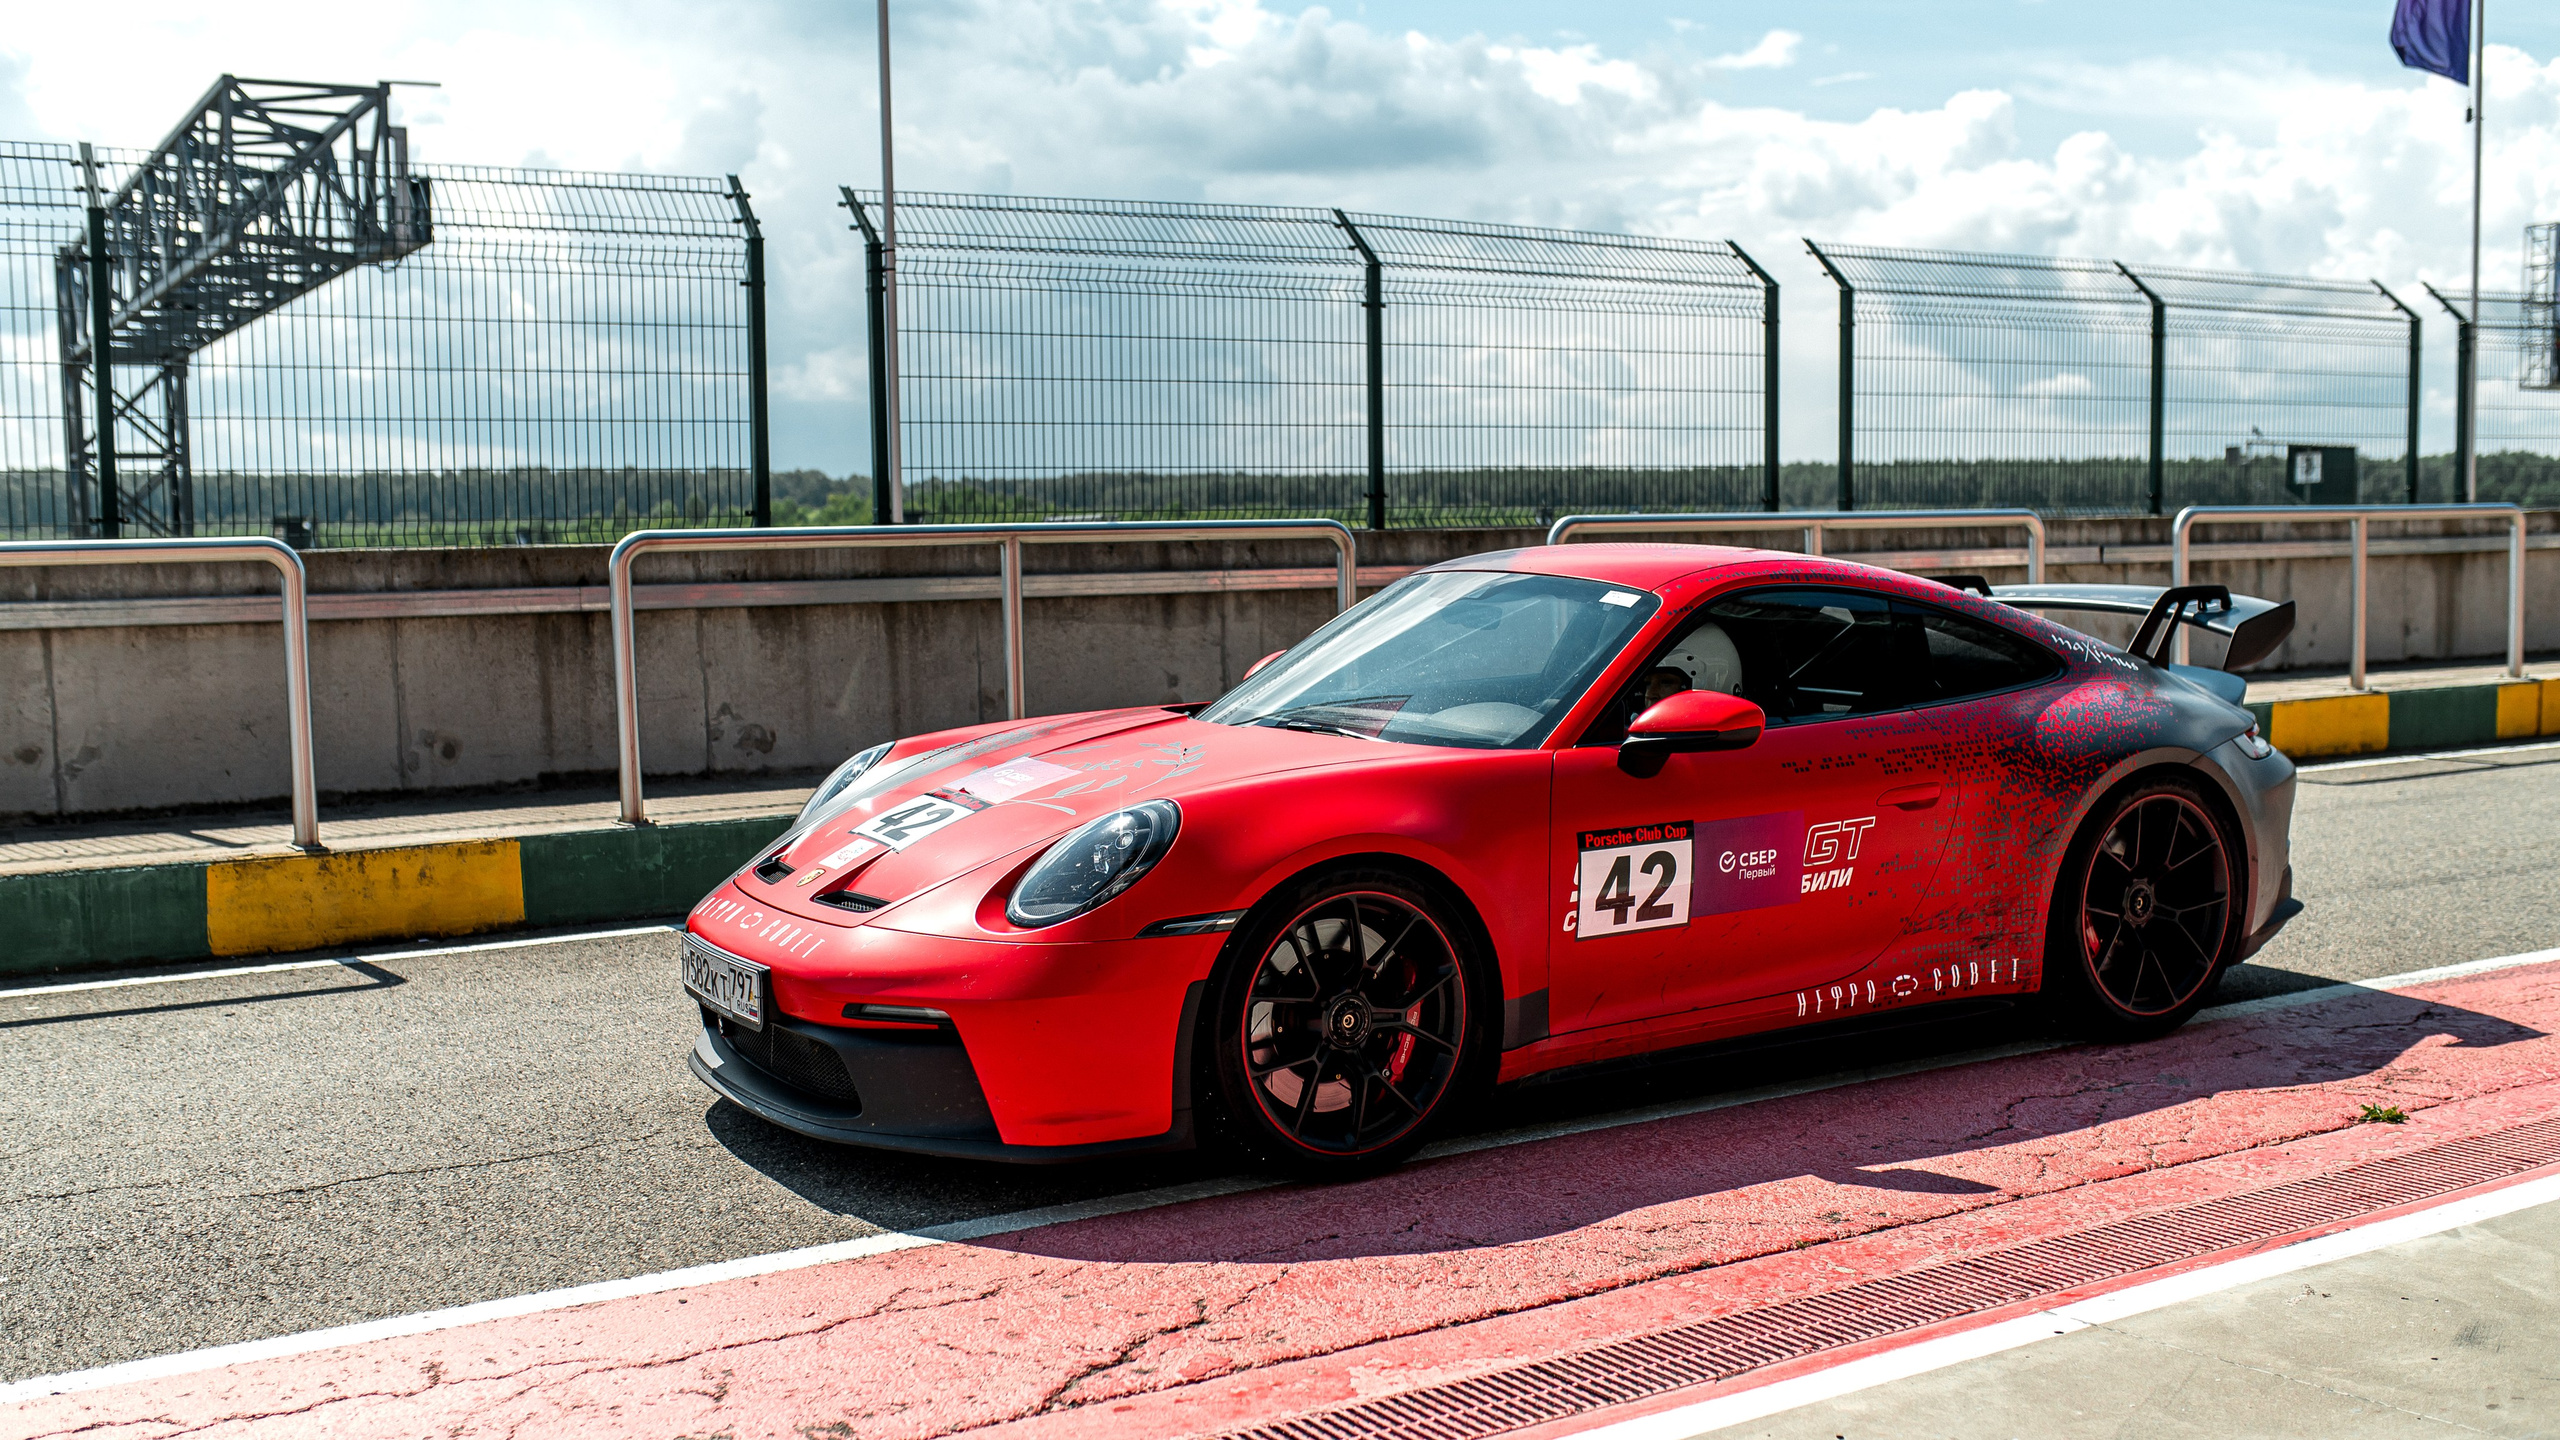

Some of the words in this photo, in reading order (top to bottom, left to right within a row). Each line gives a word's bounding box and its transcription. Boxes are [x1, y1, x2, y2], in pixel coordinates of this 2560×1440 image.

[872, 802, 955, 842] 42
[1585, 830, 1633, 848] Porsche
[1635, 826, 1662, 842] Club
[1664, 824, 1687, 840] Cup
[1739, 849, 1777, 867] СБЕР
[1803, 816, 1876, 867] GT
[1595, 850, 1677, 926] 42
[1738, 864, 1776, 881] Первый
[729, 967, 753, 1002] 797
